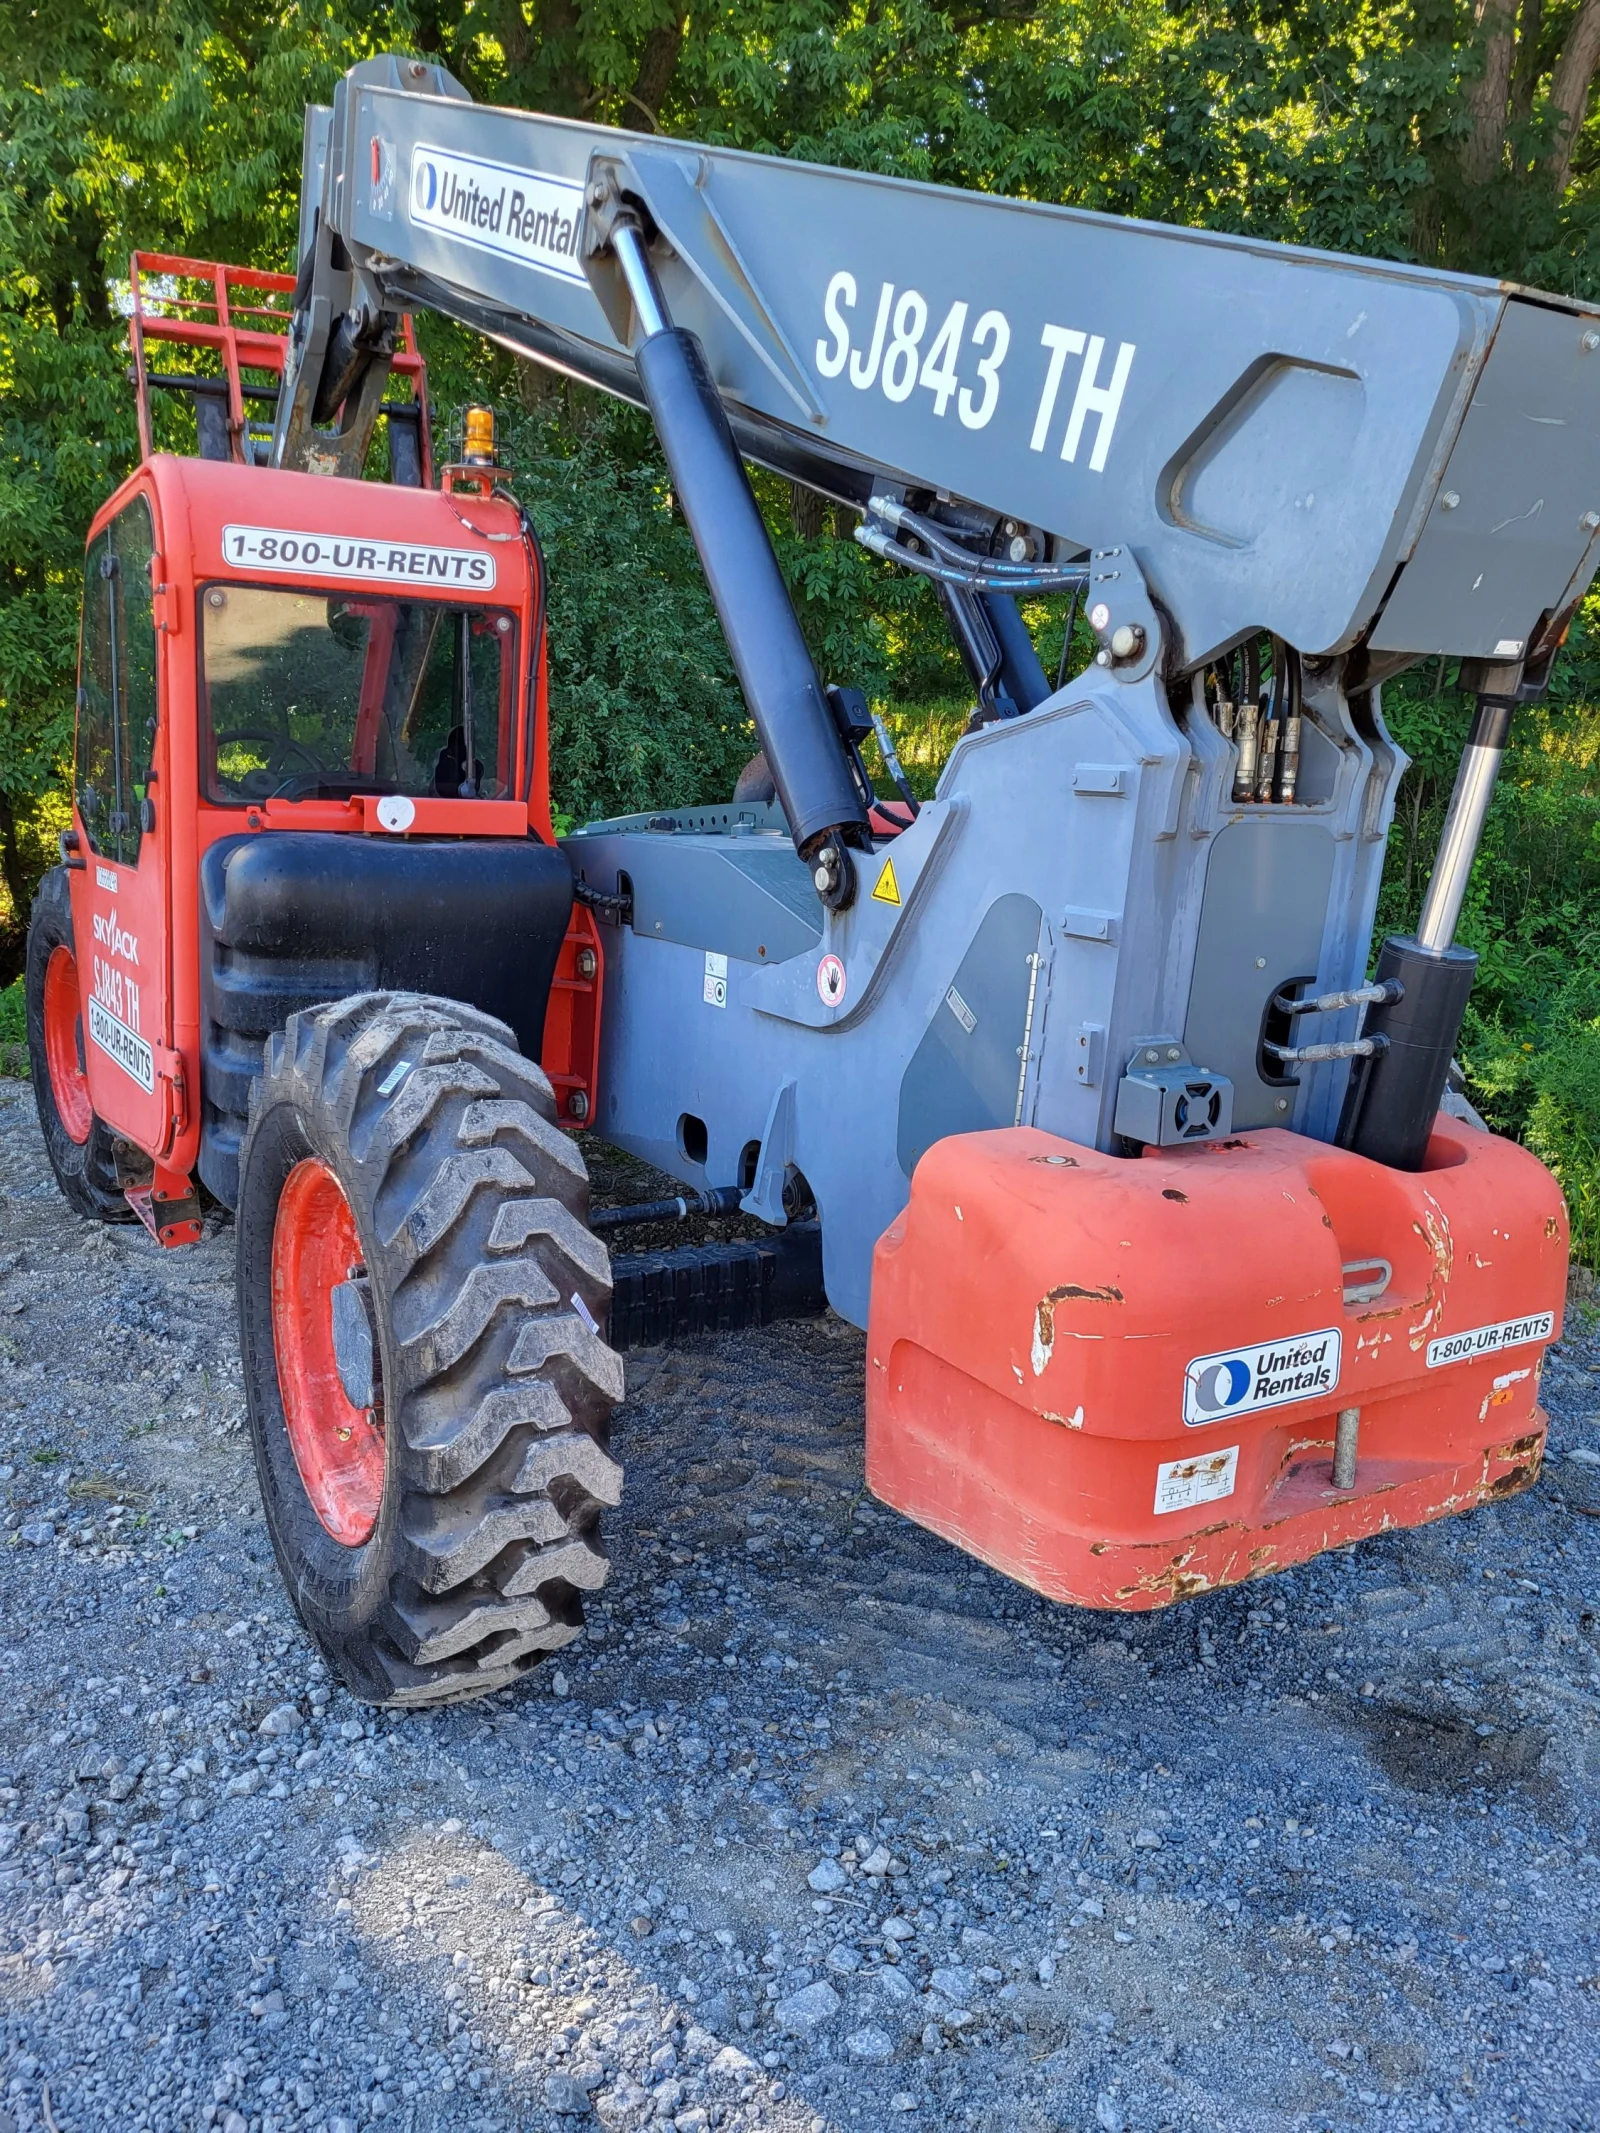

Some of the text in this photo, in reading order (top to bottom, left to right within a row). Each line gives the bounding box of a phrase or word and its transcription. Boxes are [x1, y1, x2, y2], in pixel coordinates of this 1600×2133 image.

[440, 171, 583, 257] United Rental
[815, 270, 1137, 473] SJ843 TH
[232, 535, 487, 581] 1-800-UR-RENTS
[93, 906, 140, 967] SKYJACK
[94, 954, 140, 1033] SJ843 TH
[91, 1007, 151, 1083] 1-800-UR-RENTS
[1253, 1340, 1331, 1400] United Rentals
[1432, 1317, 1550, 1361] 1-800-UR-RENTS
